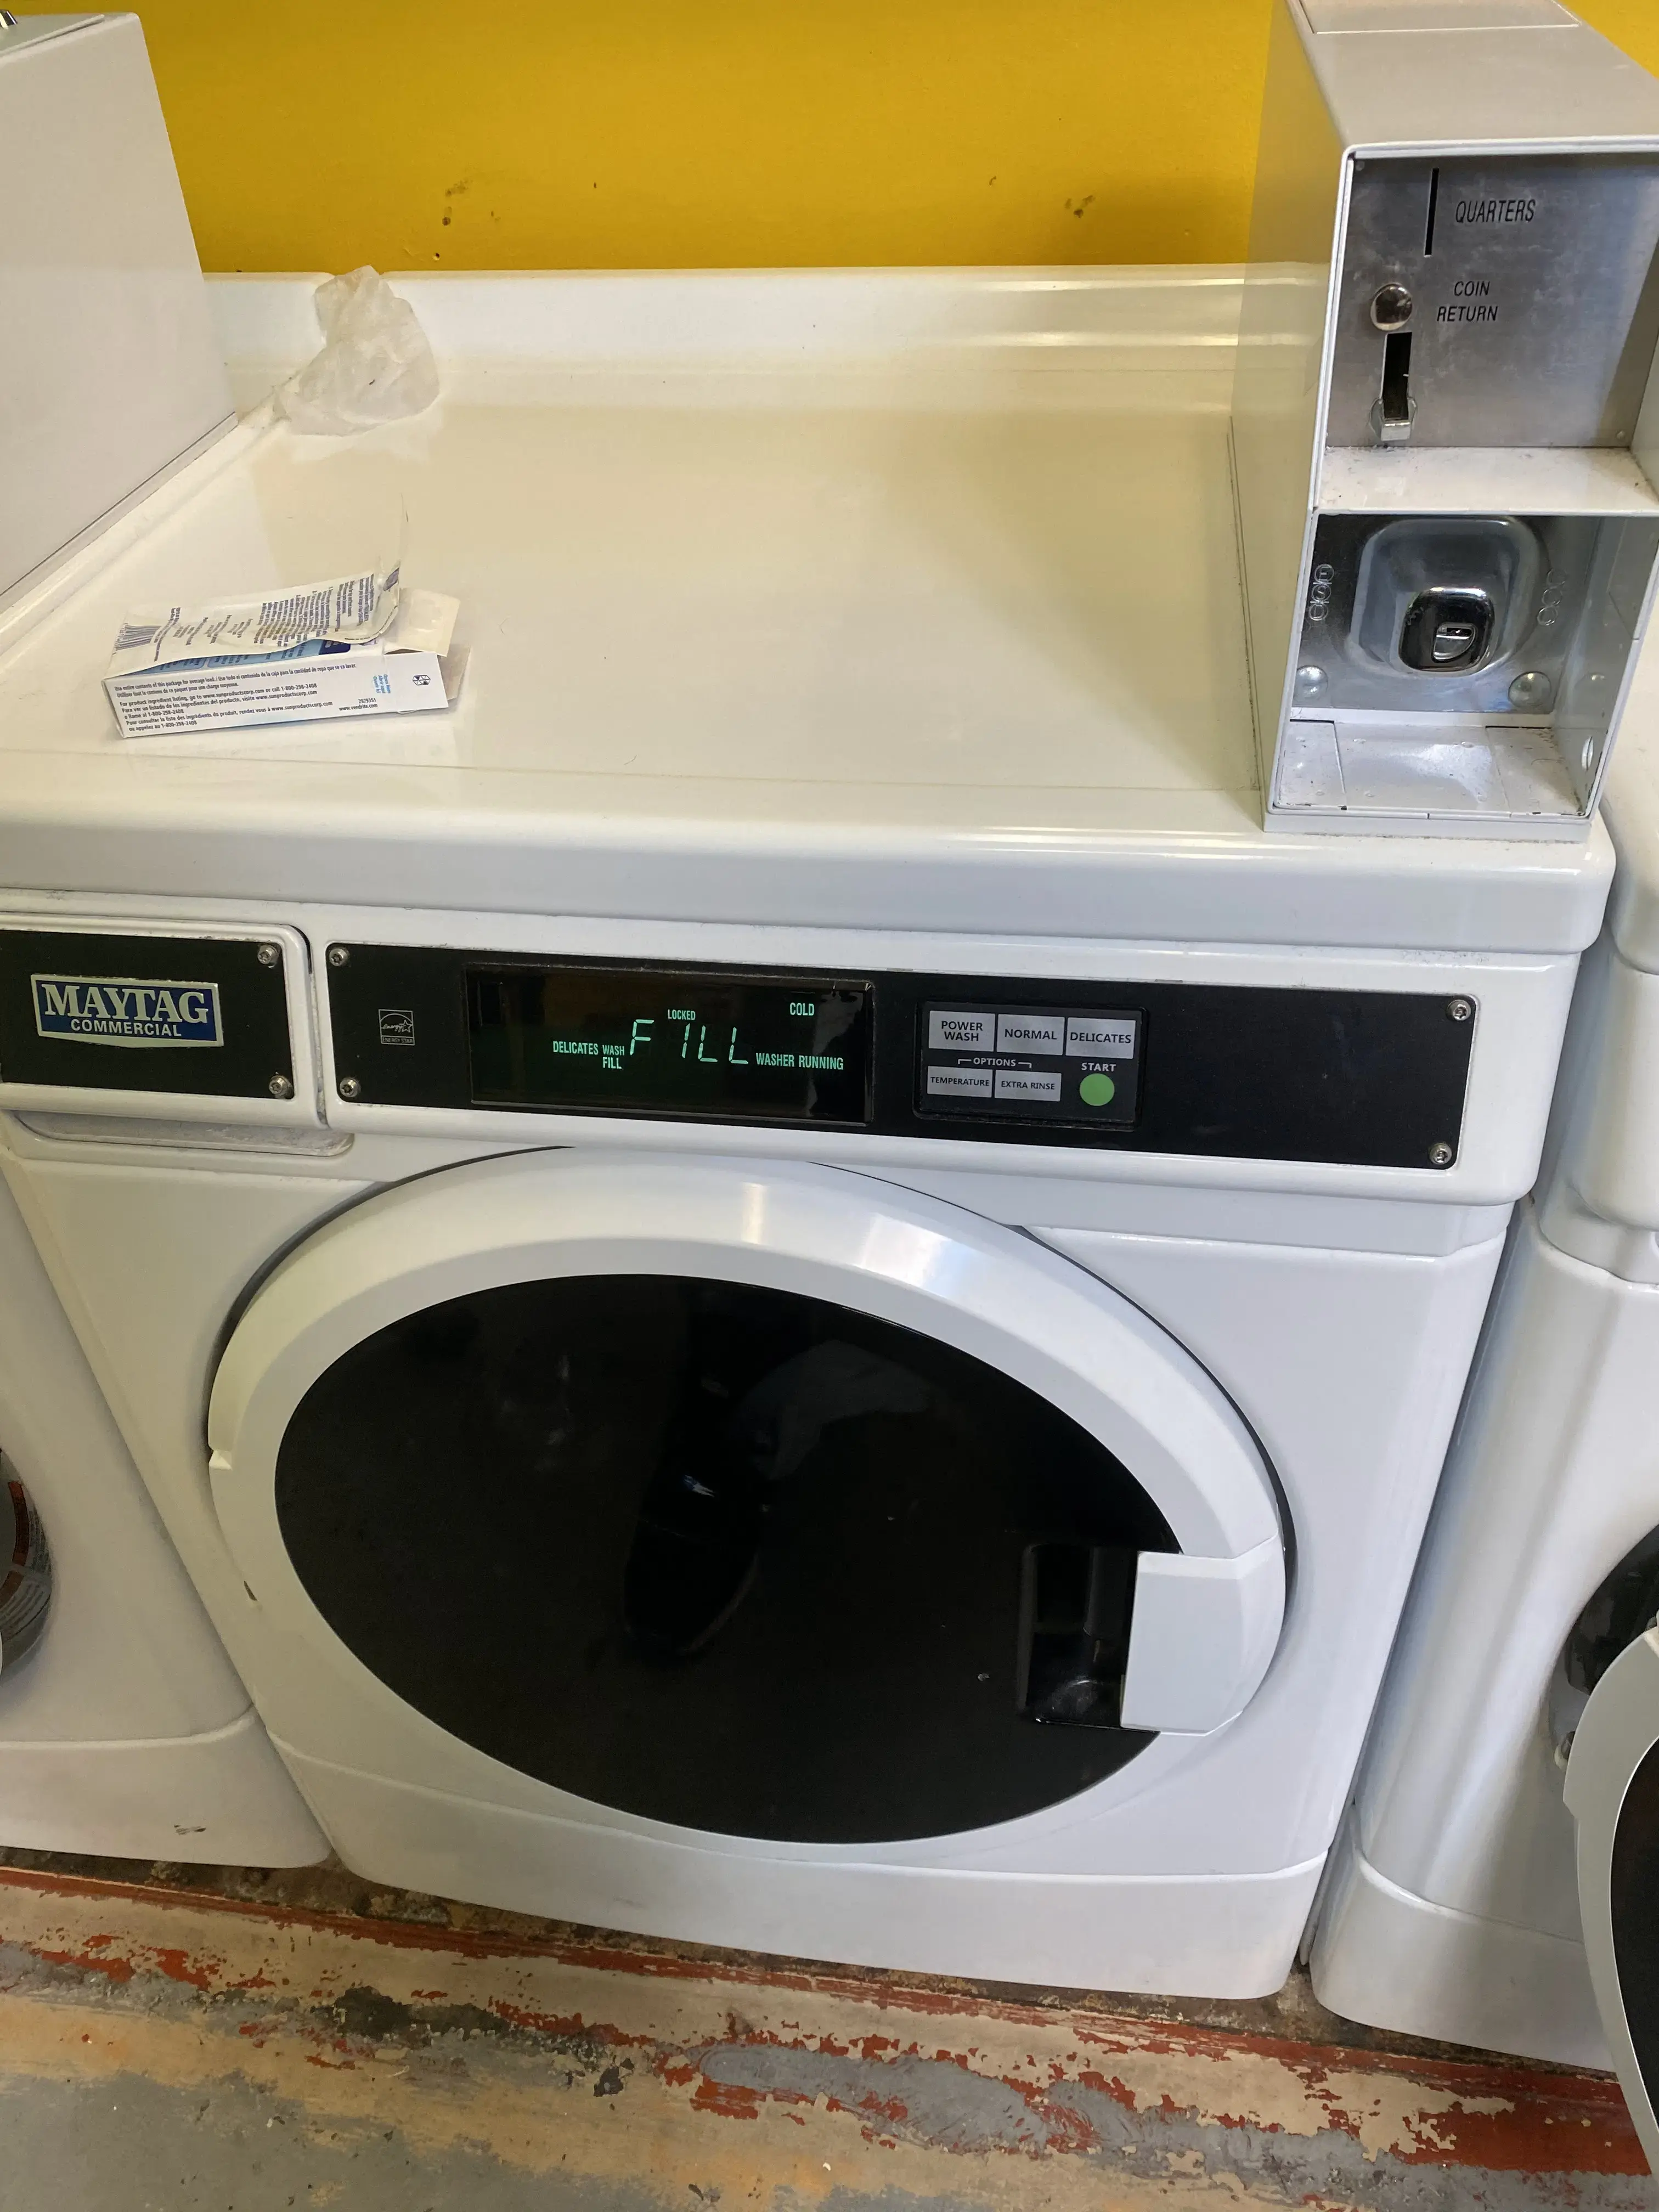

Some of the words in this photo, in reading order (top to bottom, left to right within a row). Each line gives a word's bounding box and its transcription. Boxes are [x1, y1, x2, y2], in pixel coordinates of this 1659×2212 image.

[1455, 198, 1536, 223] QUARTERS
[1453, 280, 1490, 297] COIN
[1436, 306, 1498, 323] RETURN
[202, 690, 264, 698] www.sunproductscorp.com
[281, 684, 317, 693] 1-800-298-2408
[256, 691, 317, 699] www.sunproductscorp.com
[272, 702, 332, 711] www.sunproductscorp.com
[41, 983, 209, 1024] MAYTAG
[789, 1002, 815, 1017] COLD
[667, 1009, 696, 1020] LOCKED
[70, 1019, 182, 1036] COMMERCIAL
[940, 1020, 984, 1031] POWER
[944, 1031, 980, 1042] WASH
[1004, 1029, 1057, 1040] NORMAL
[1069, 1032, 1132, 1044] DELICATES
[552, 1041, 599, 1056] DELICATES
[602, 1045, 625, 1056] WASH
[602, 1057, 622, 1070] FILL
[756, 1053, 795, 1068] WASHER
[799, 1056, 844, 1070] RUNNING
[973, 1057, 1016, 1067] OPTIONS
[1081, 1063, 1116, 1073] START
[930, 1076, 990, 1087] TEMPERATURE
[1001, 1081, 1028, 1090] EXTRA
[1030, 1081, 1055, 1091] RINSE
